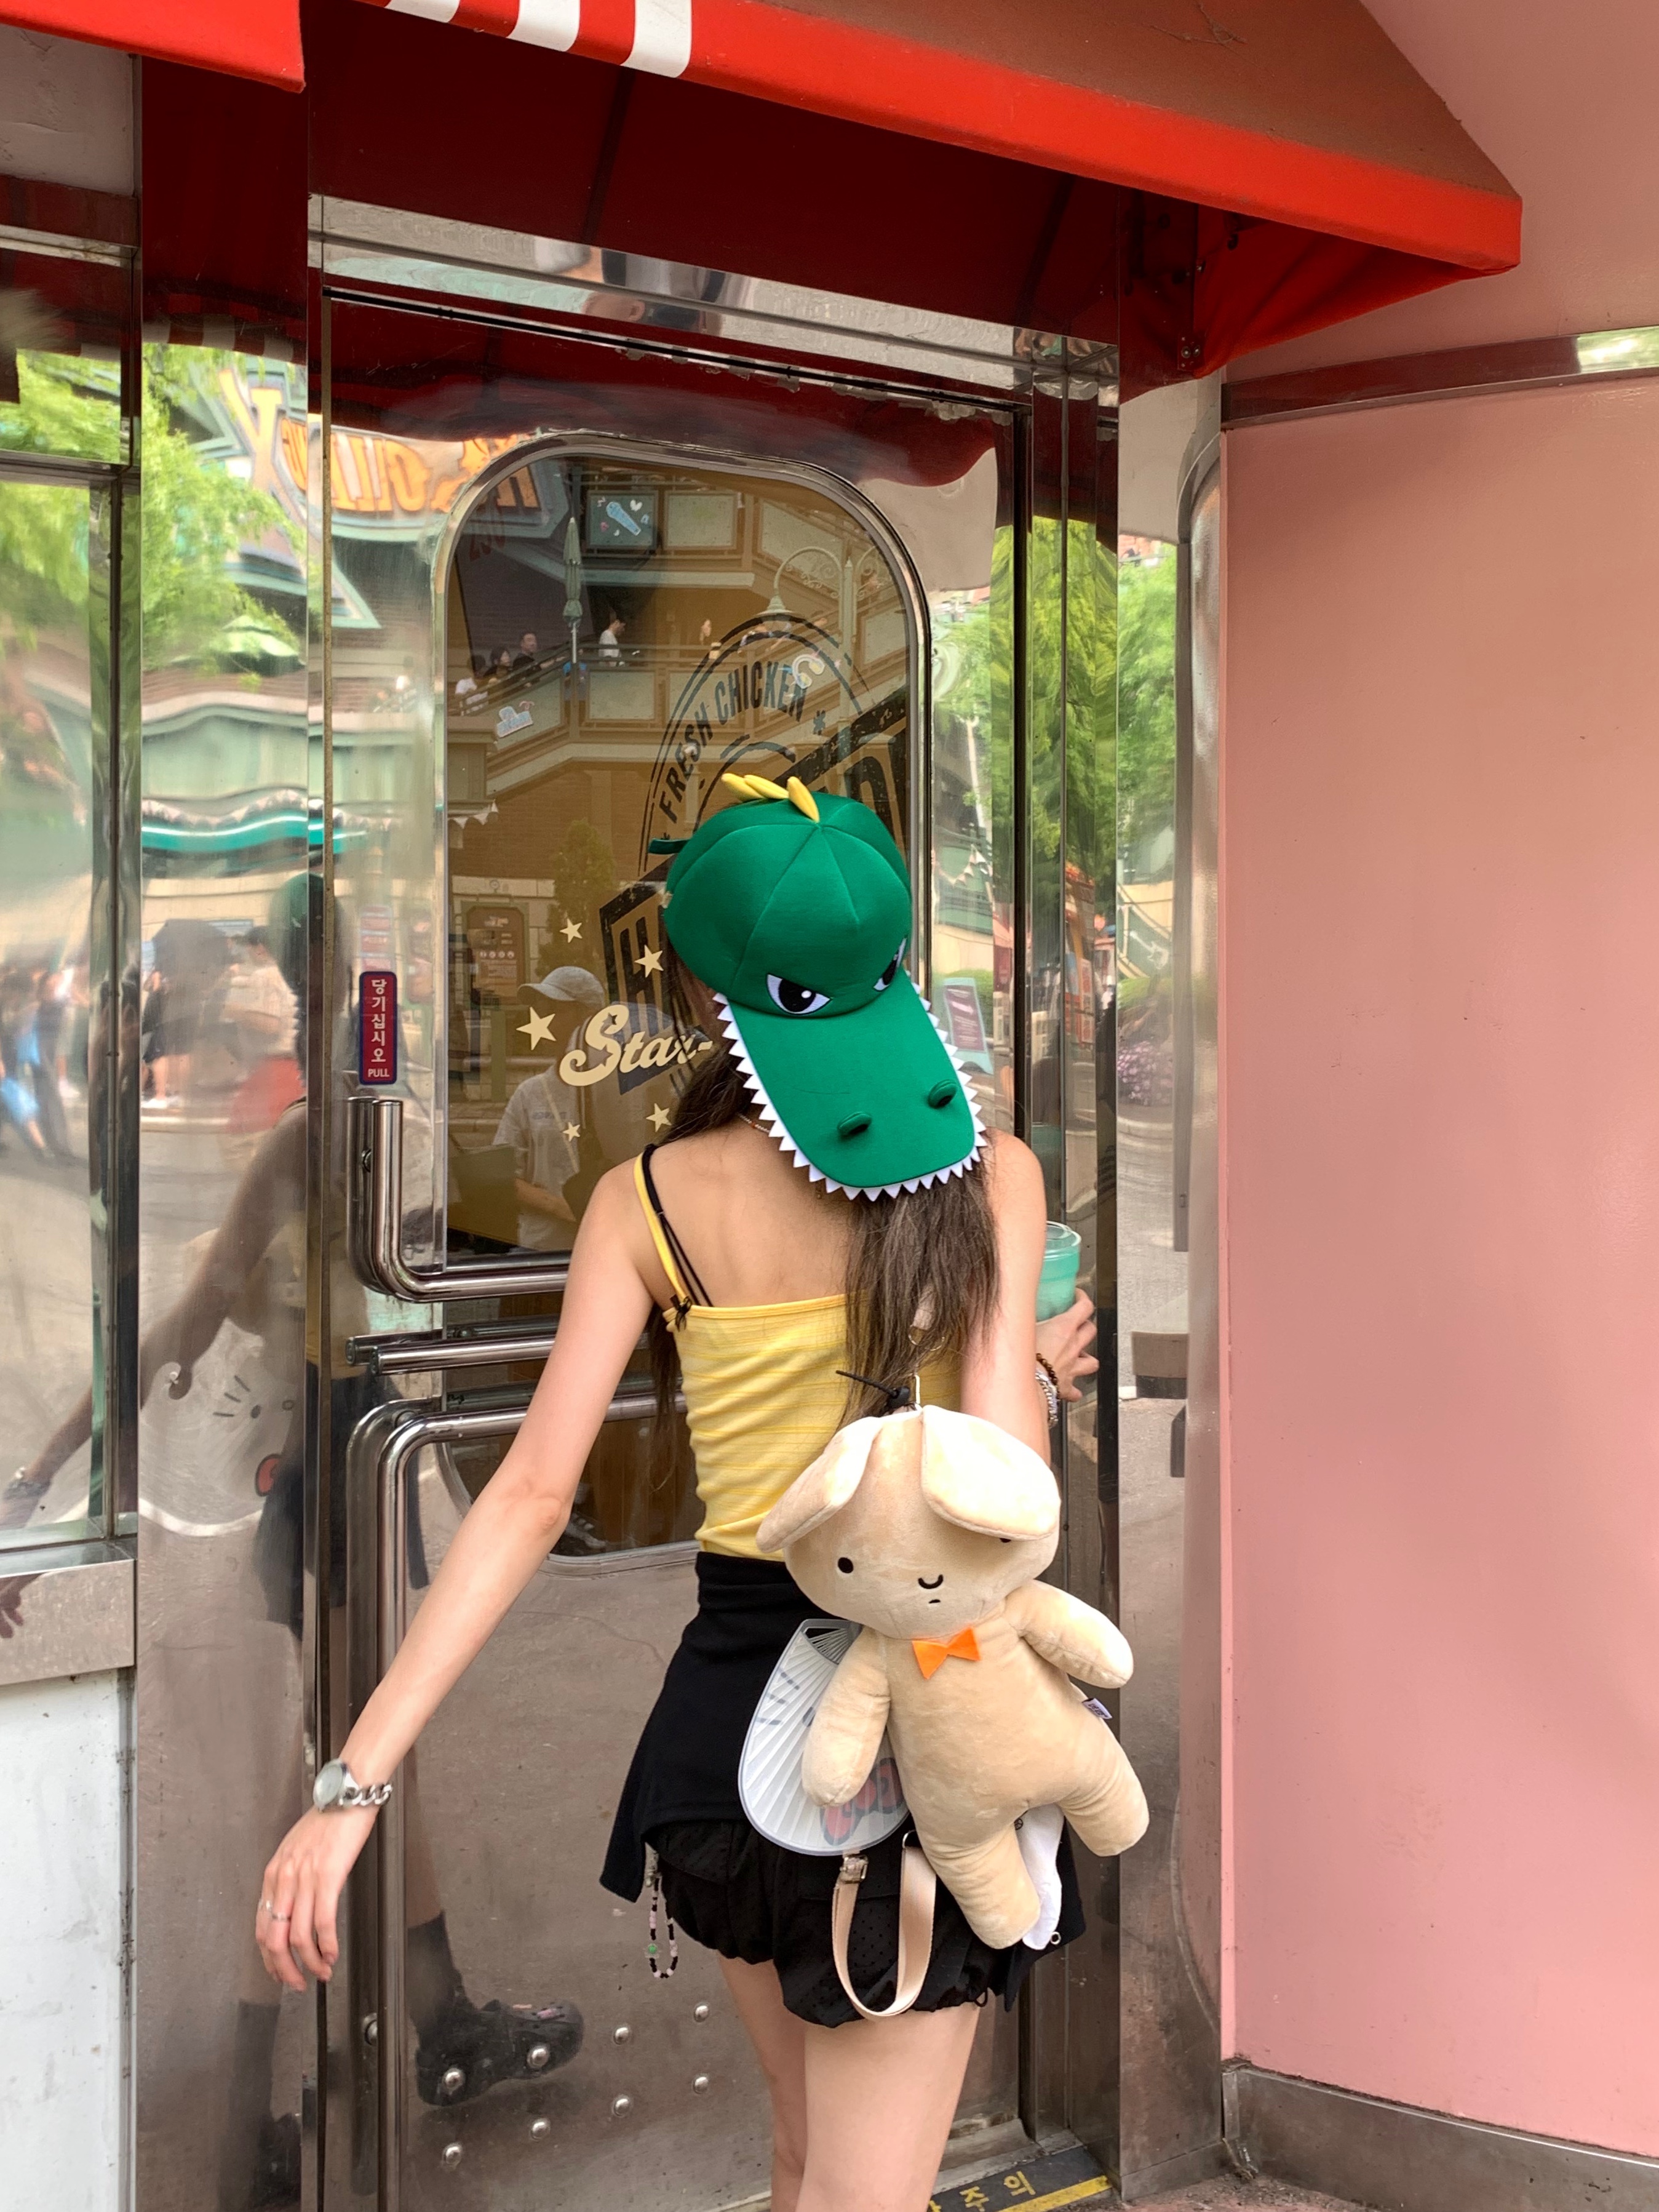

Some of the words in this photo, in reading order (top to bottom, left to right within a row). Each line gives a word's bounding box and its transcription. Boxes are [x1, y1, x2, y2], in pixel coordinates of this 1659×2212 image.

[659, 701, 714, 823] FRESH
[715, 660, 808, 722] CHICKEN
[370, 978, 388, 1063] 당기십시오
[368, 1068, 390, 1078] PULL
